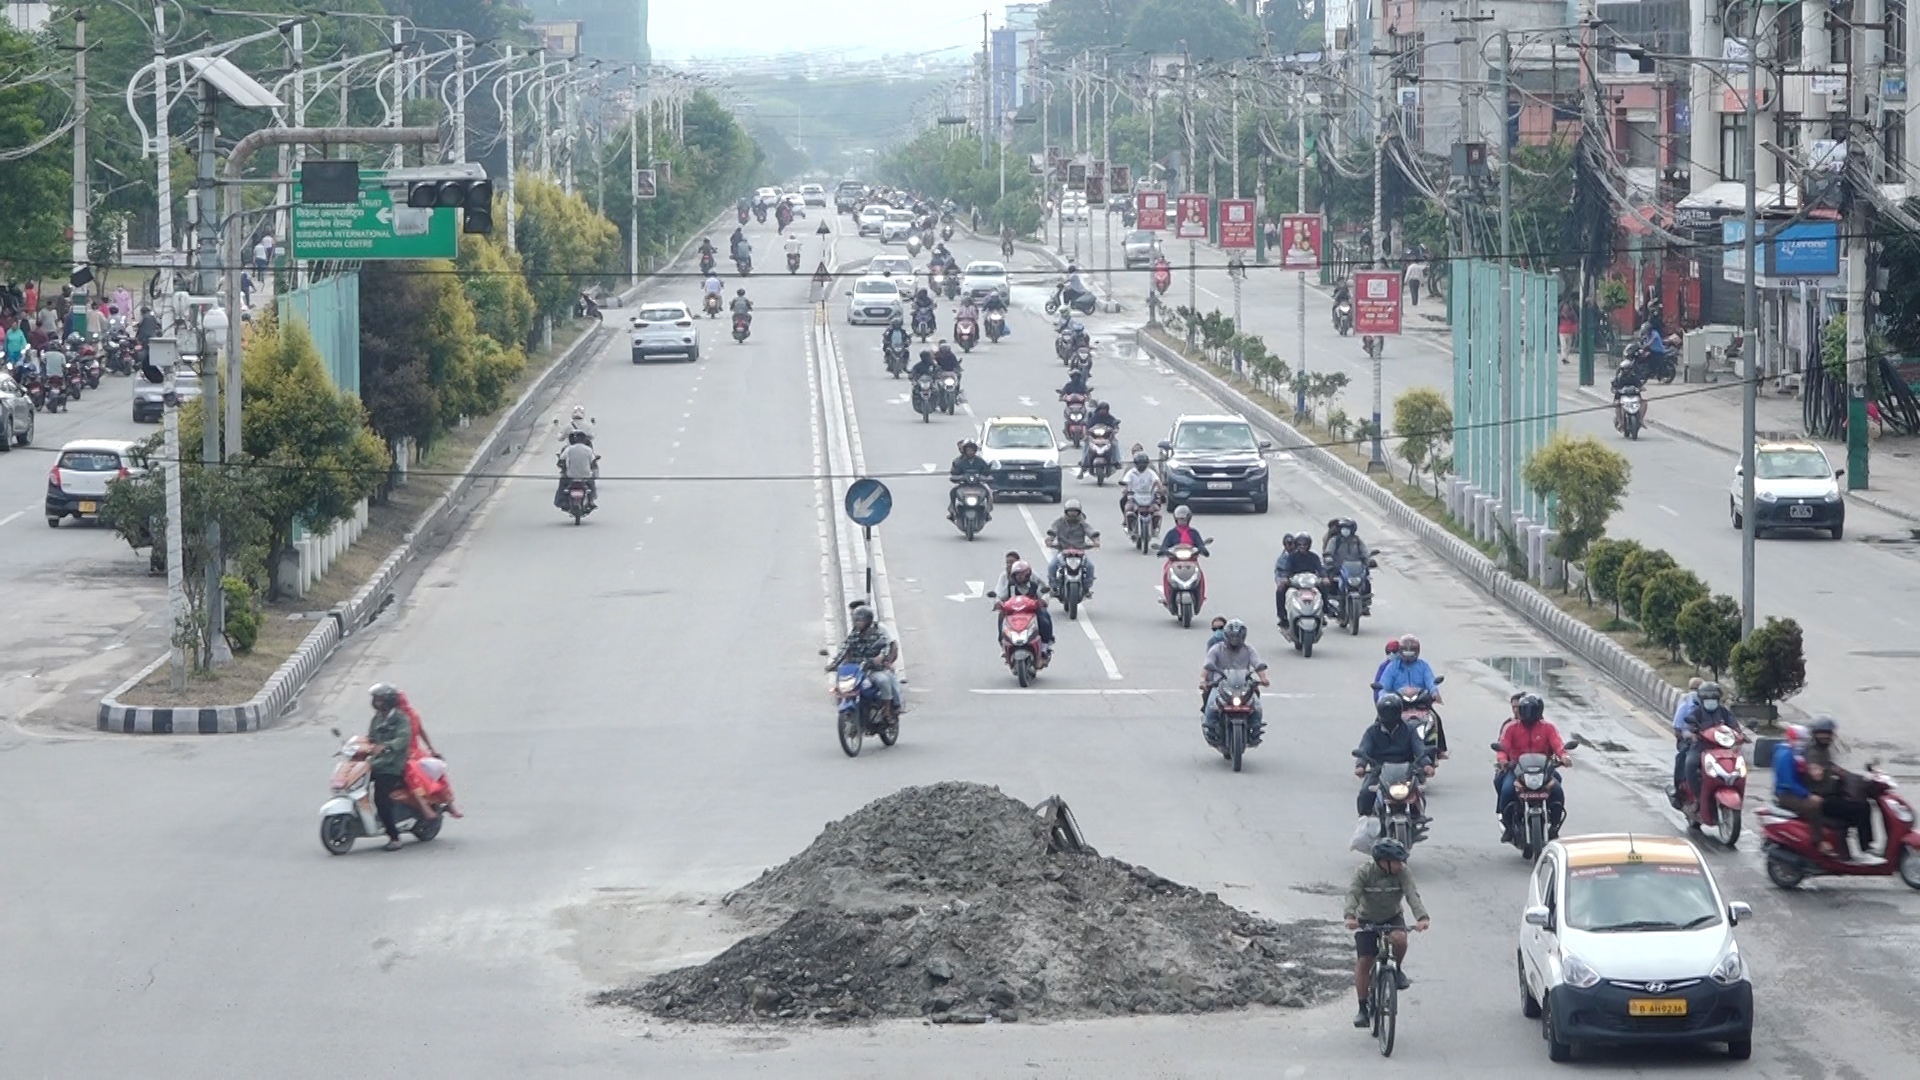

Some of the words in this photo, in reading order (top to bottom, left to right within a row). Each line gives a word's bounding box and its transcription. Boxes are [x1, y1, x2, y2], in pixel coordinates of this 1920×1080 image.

[361, 199, 382, 208] TRUST
[296, 230, 333, 238] BIRENDRA
[334, 229, 391, 238] INTERNATIONAL
[296, 240, 343, 248] CONVENTION
[343, 239, 374, 248] CENTRE
